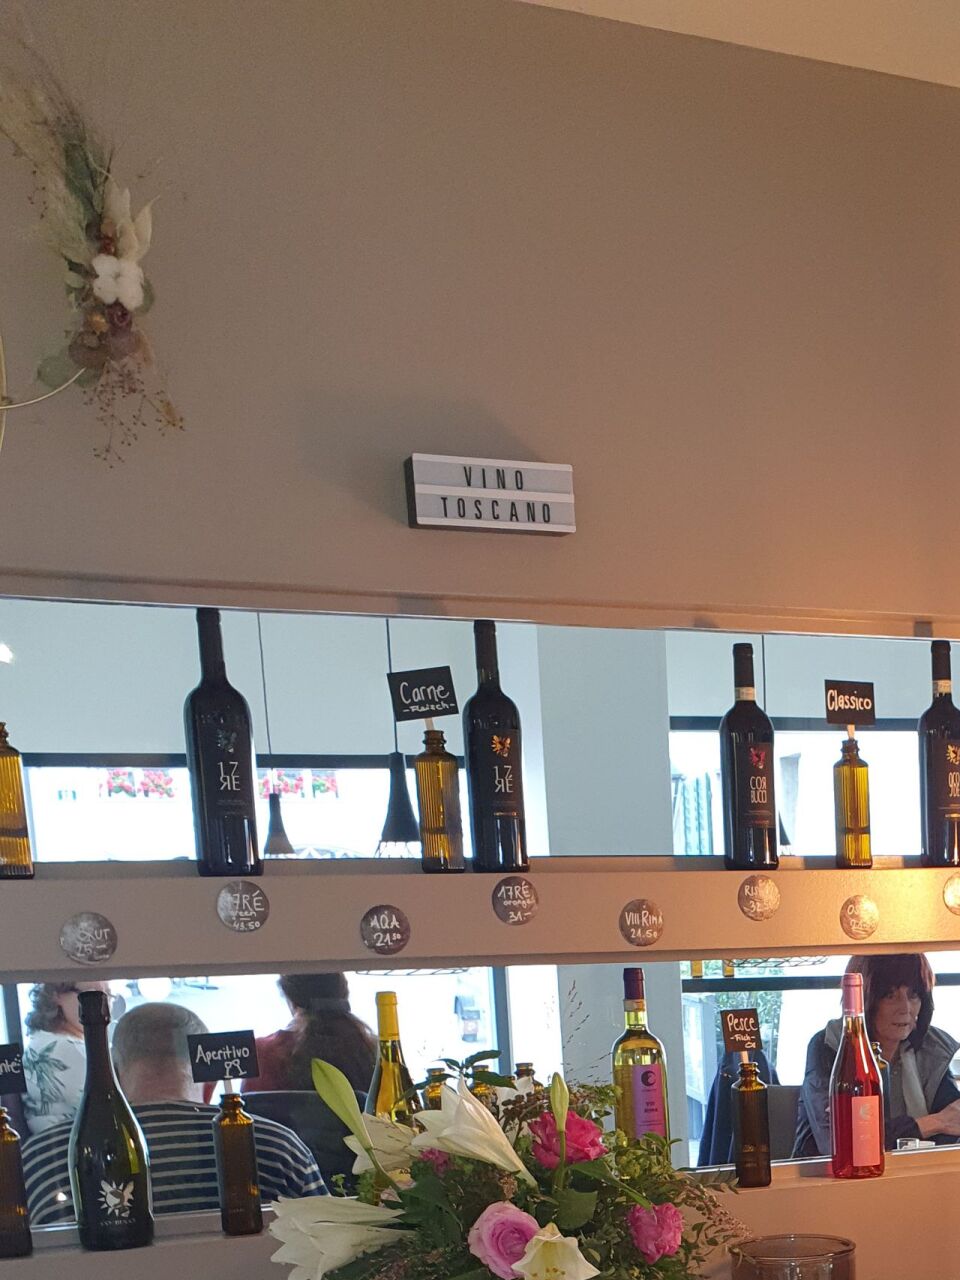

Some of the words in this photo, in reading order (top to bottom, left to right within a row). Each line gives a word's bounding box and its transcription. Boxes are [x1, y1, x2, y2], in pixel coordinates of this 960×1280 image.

[464, 466, 523, 490] VINO
[440, 496, 551, 523] TOSCANO
[399, 681, 450, 704] Carne
[827, 689, 873, 711] Classico
[727, 1013, 759, 1032] Pesce
[195, 1044, 250, 1066] Aperitivo
